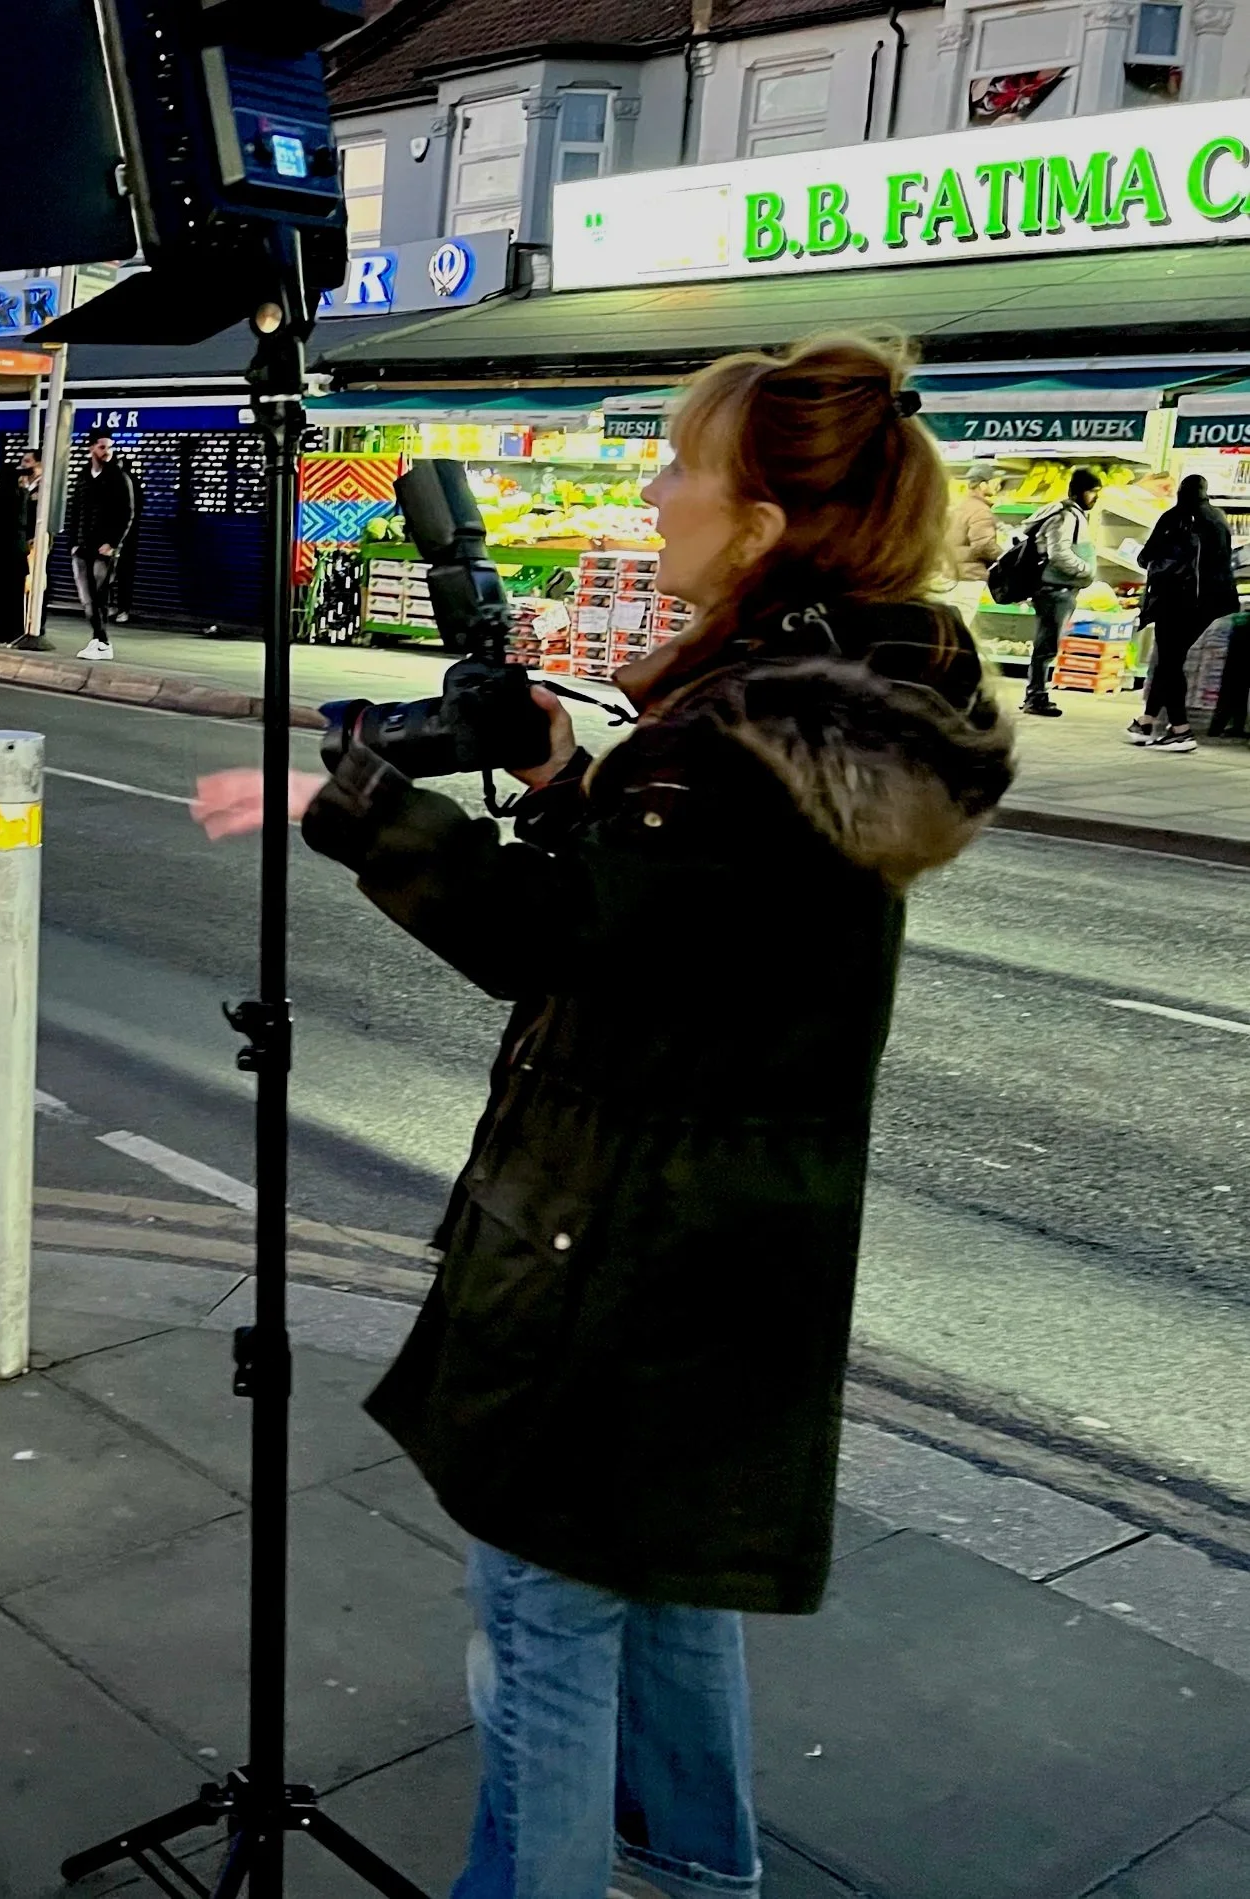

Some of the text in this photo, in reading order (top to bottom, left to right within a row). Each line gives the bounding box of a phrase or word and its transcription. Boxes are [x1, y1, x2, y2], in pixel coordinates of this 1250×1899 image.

[743, 136, 1250, 261] B.B. FATIMA C
[607, 421, 656, 438] FRESH
[964, 419, 1137, 438] 7 DAYS A WEEK
